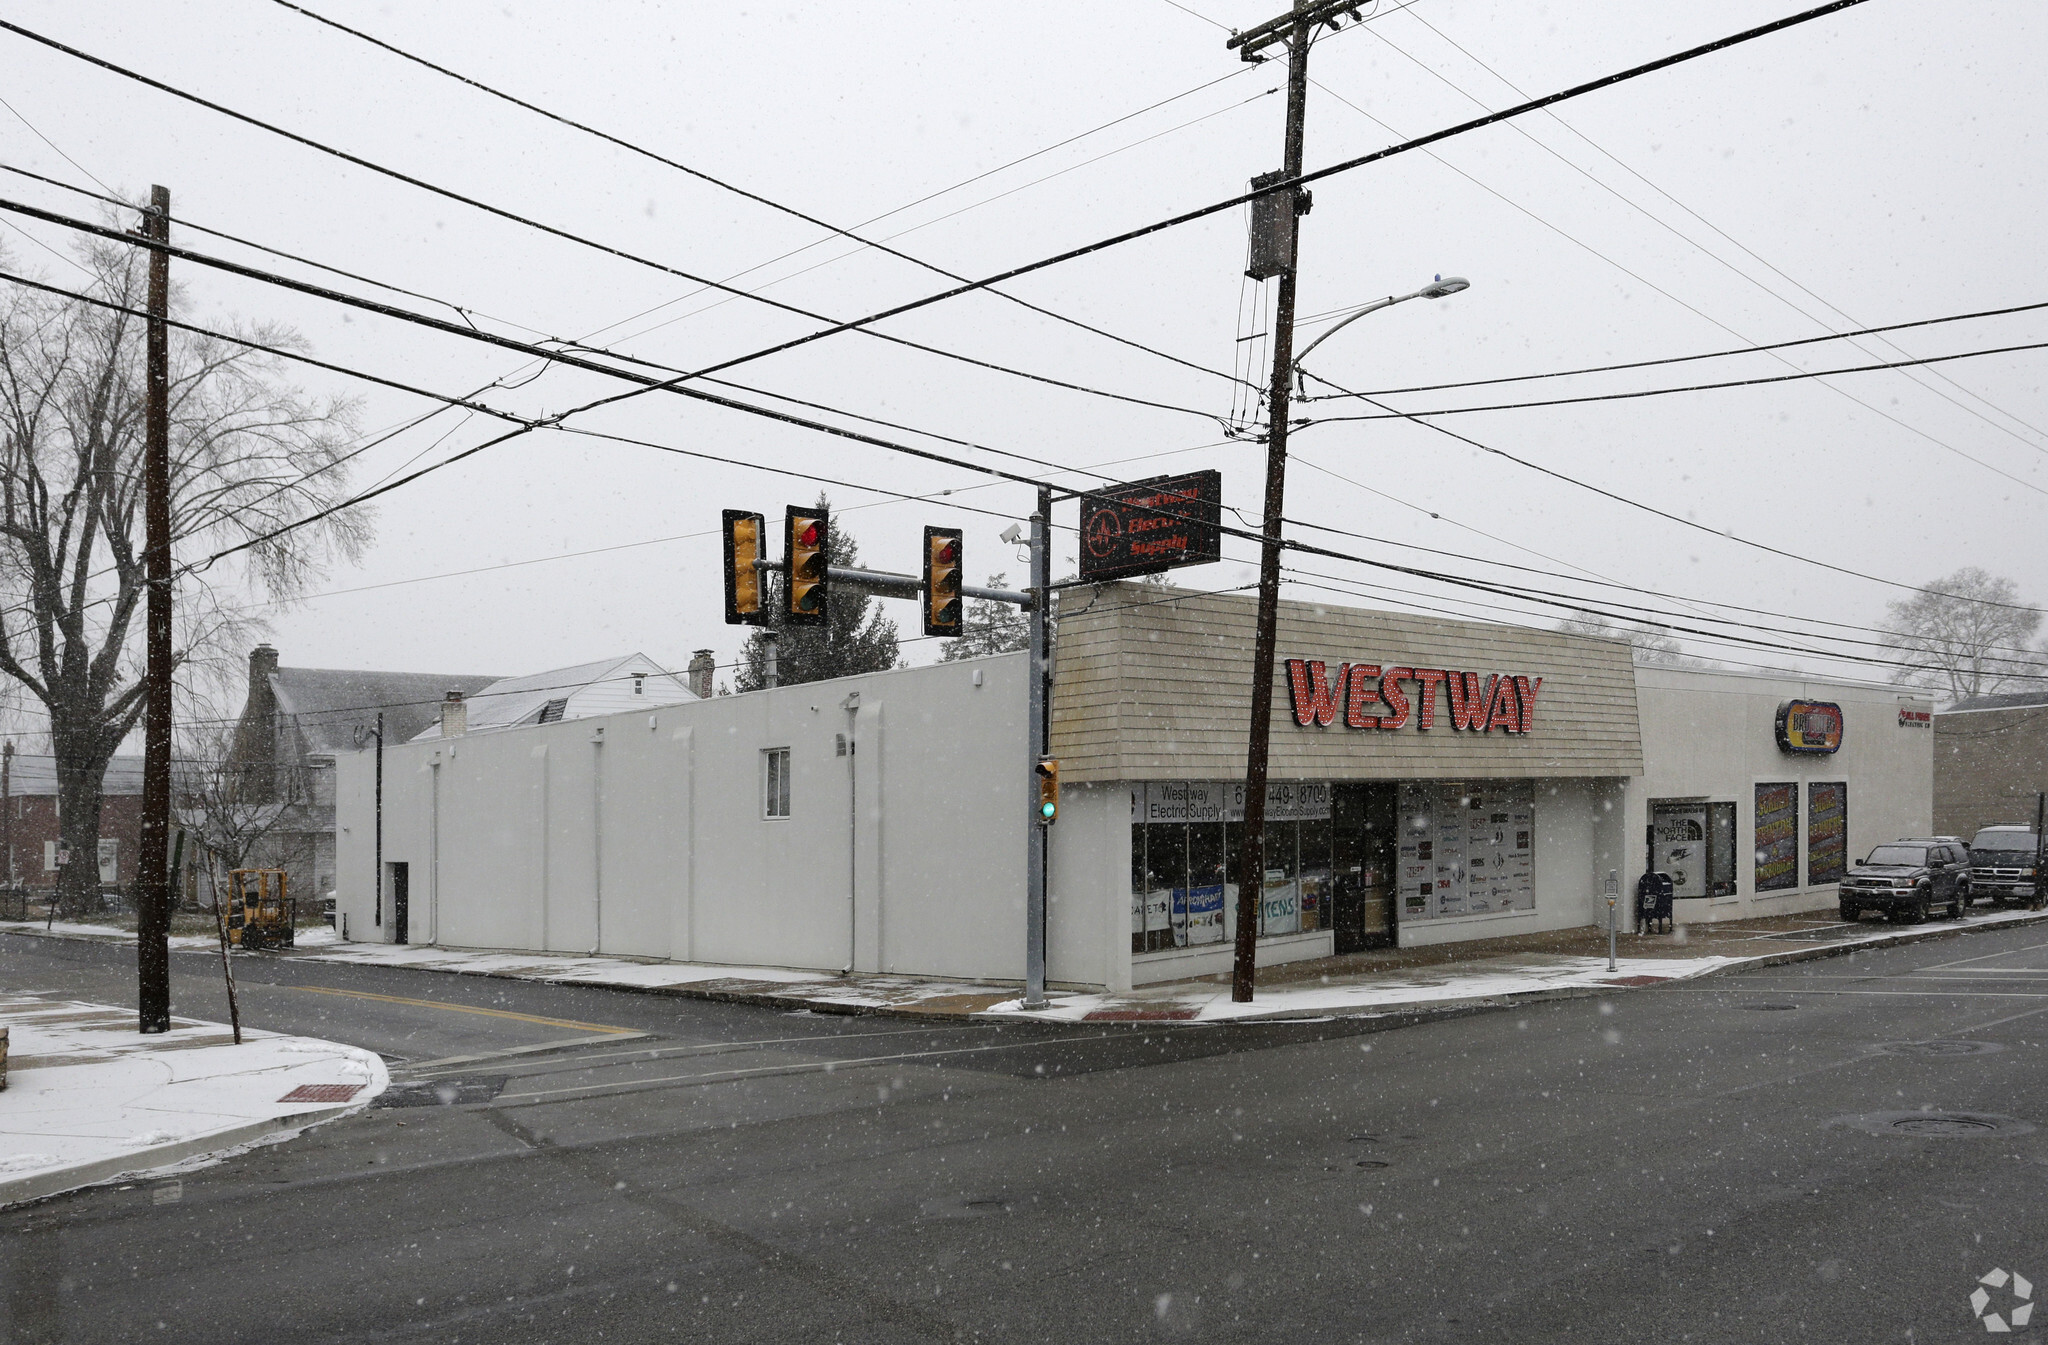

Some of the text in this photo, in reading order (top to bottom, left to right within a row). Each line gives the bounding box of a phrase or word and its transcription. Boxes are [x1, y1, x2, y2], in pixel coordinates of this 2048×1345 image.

[1130, 534, 1188, 556] Supply
[1284, 658, 1543, 733] WESTWAY
[1150, 804, 1187, 819] Electric
[1188, 804, 1221, 821] Supply
[1670, 819, 1687, 827] THE
[1657, 827, 1688, 835] NORTH
[1665, 834, 1687, 842] FACE
[1437, 880, 1451, 889] 3M
